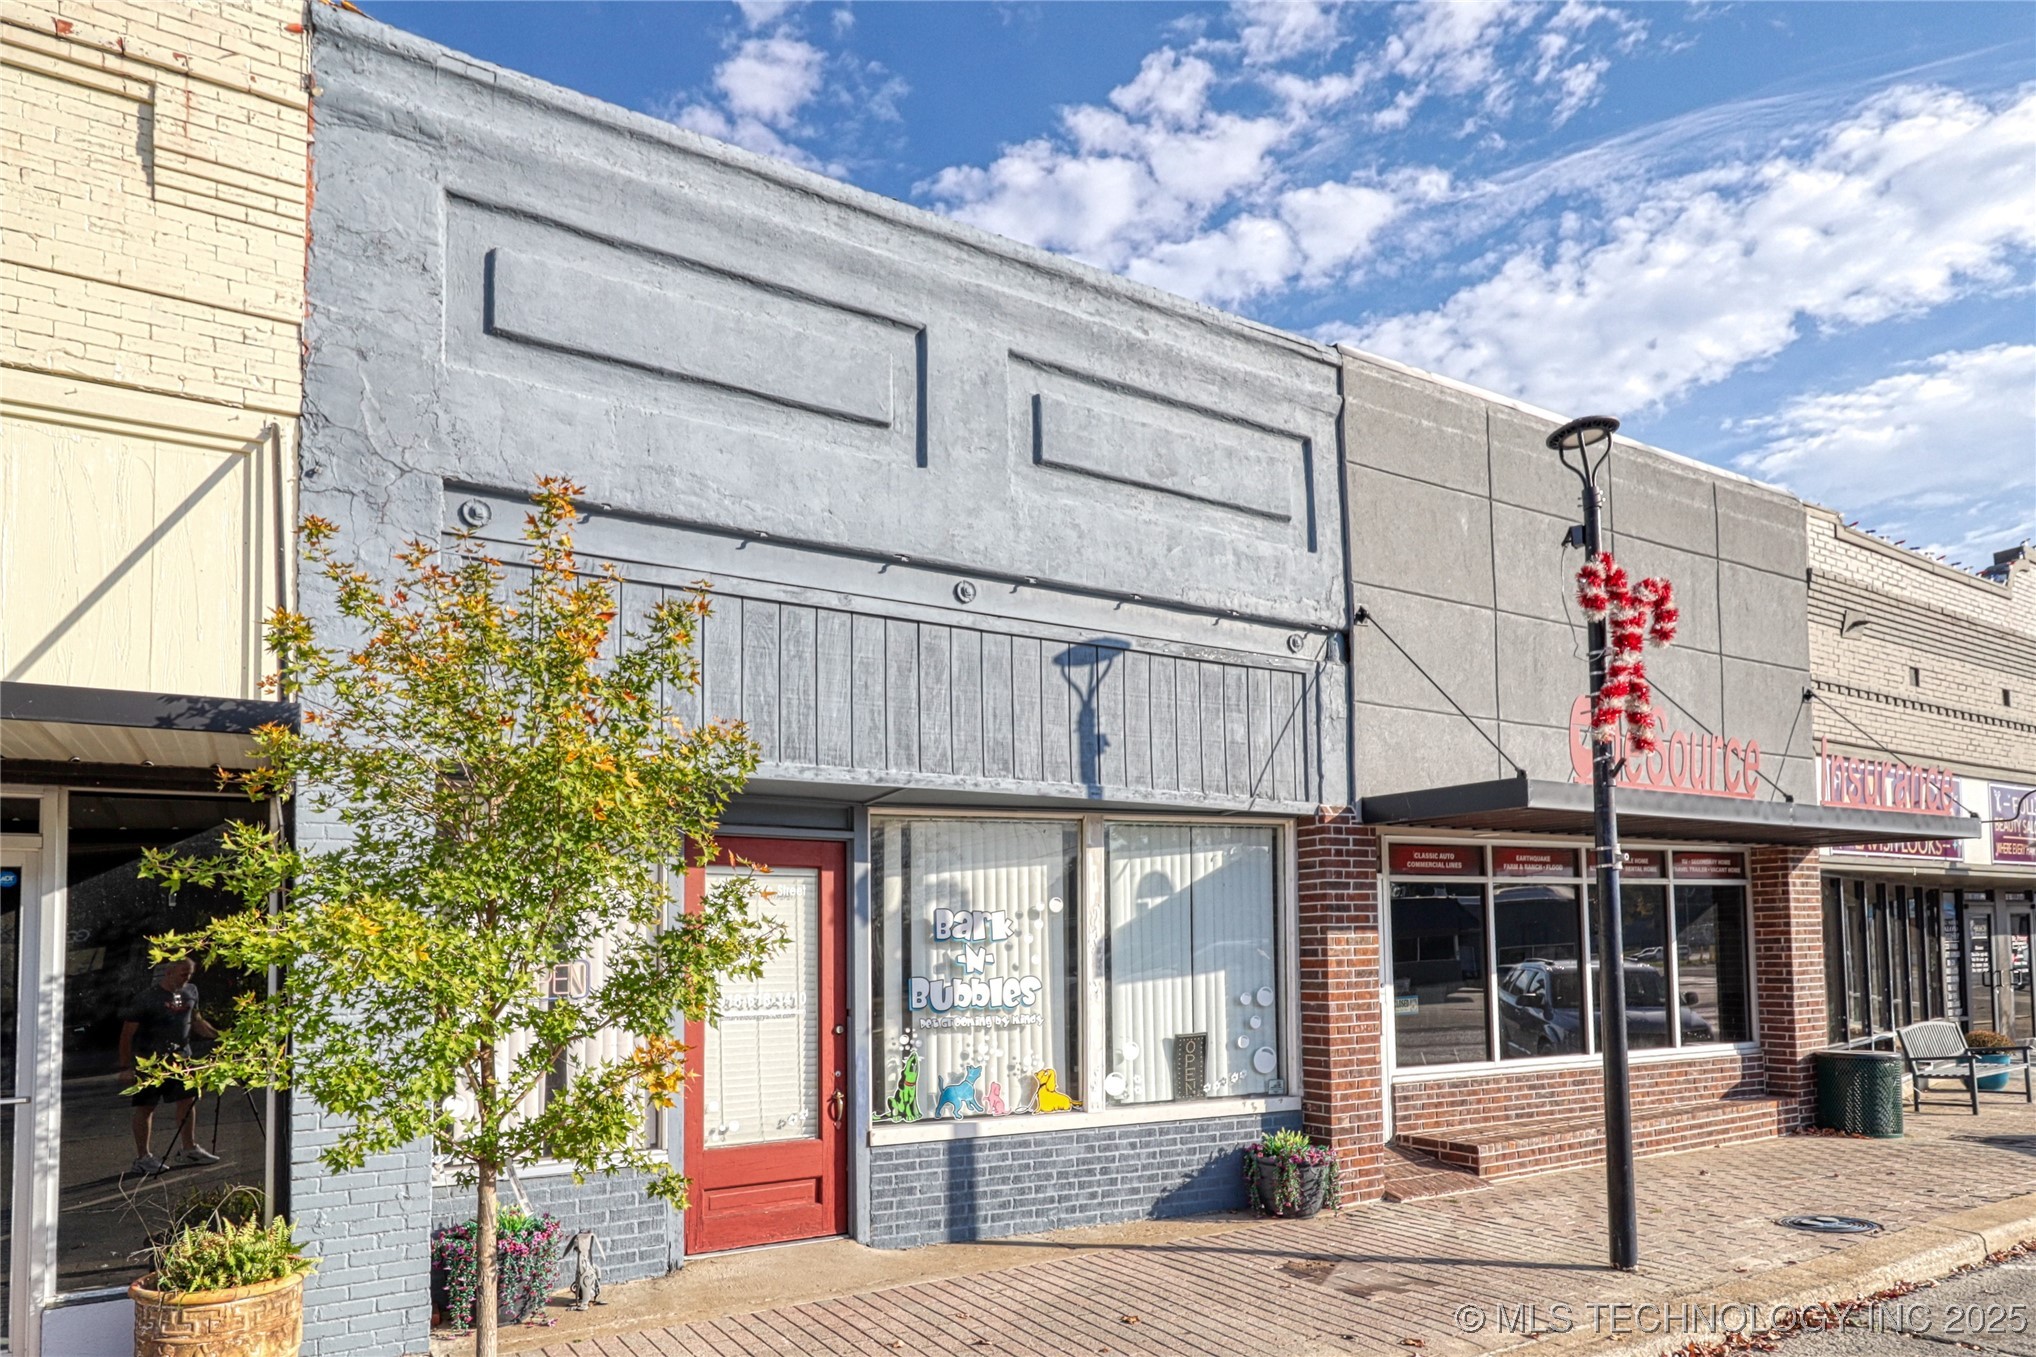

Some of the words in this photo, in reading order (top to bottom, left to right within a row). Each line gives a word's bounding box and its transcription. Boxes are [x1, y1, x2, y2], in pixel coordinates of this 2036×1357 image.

[1821, 736, 1953, 813] Insurance
[1995, 817, 2021, 834] BEAUTY
[1407, 861, 1445, 869] COMMERCIAL
[1413, 852, 1438, 860] CLASSIC
[777, 884, 806, 898] Street
[934, 908, 1014, 942] Bark
[536, 963, 586, 995] PEN
[908, 976, 1042, 1013] Bubbles
[995, 1015, 1010, 1028] by
[1184, 1040, 1196, 1096] OPEN
